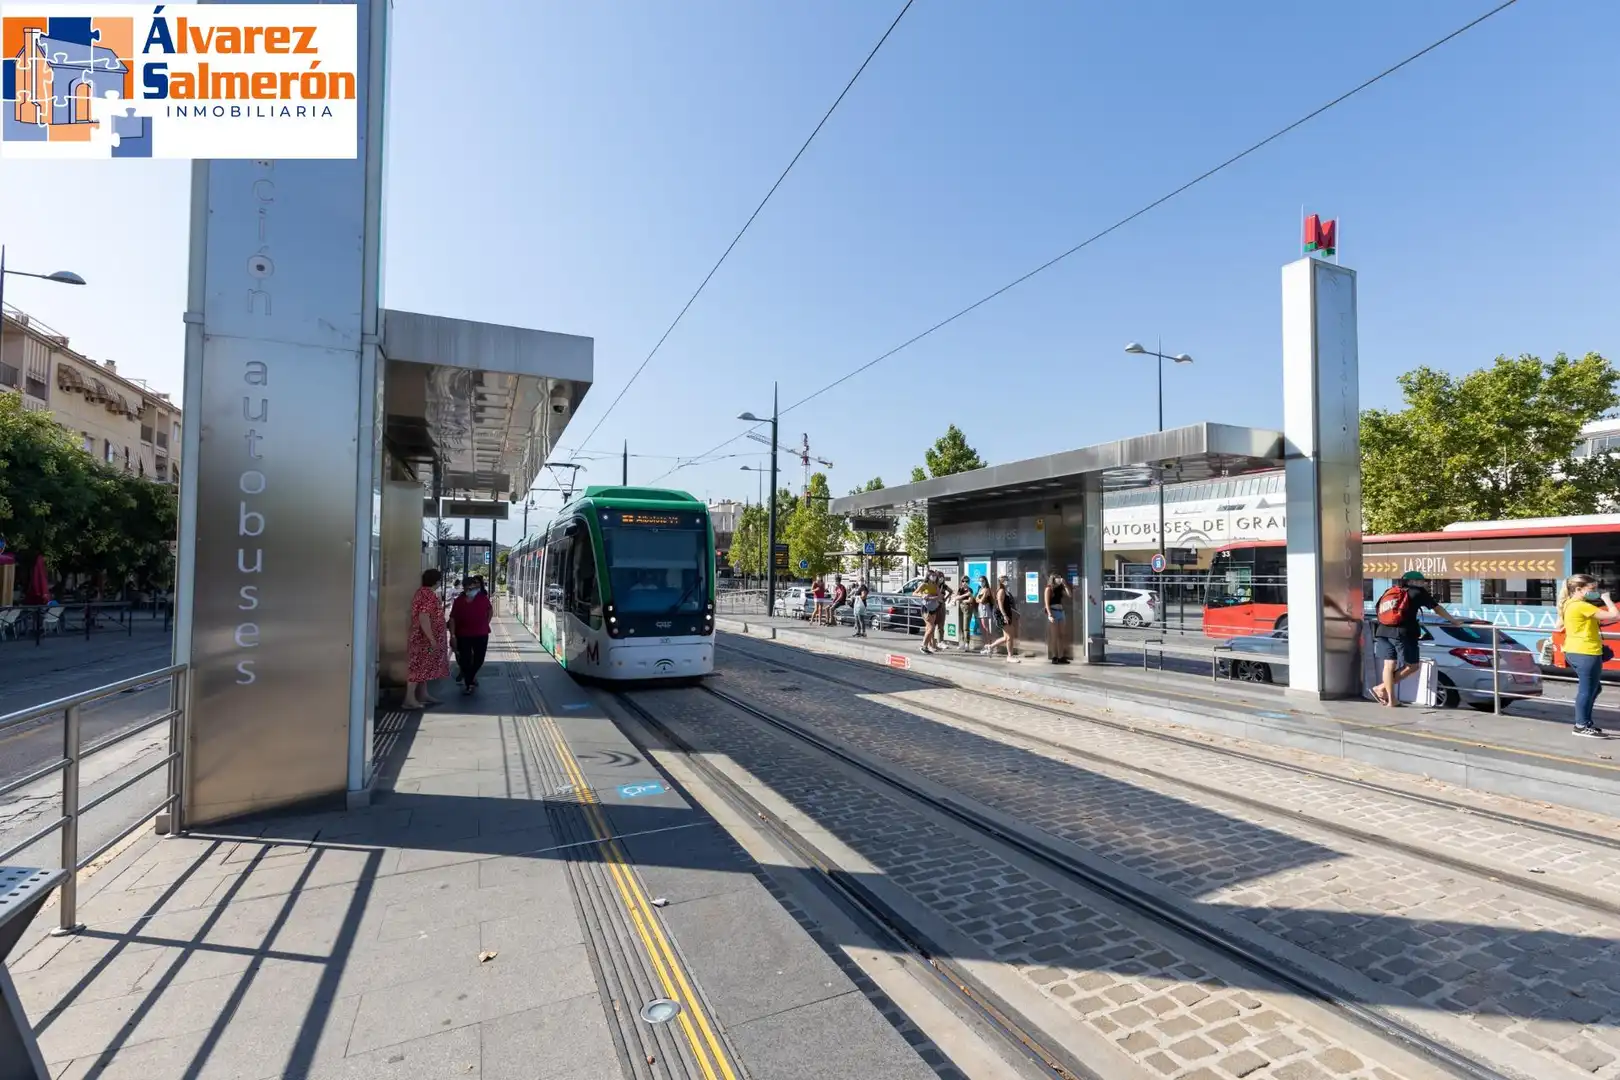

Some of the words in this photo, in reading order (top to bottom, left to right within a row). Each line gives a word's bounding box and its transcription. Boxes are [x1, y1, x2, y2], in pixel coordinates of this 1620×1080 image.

[1304, 213, 1336, 257] M
[234, 360, 268, 685] autobuses
[1103, 520, 1193, 537] AUTOBUSES
[1203, 518, 1225, 532] DE
[1221, 550, 1231, 558] 33
[1404, 557, 1414, 573] LA
[1416, 557, 1448, 573] PEPITA
[586, 640, 600, 666] M
